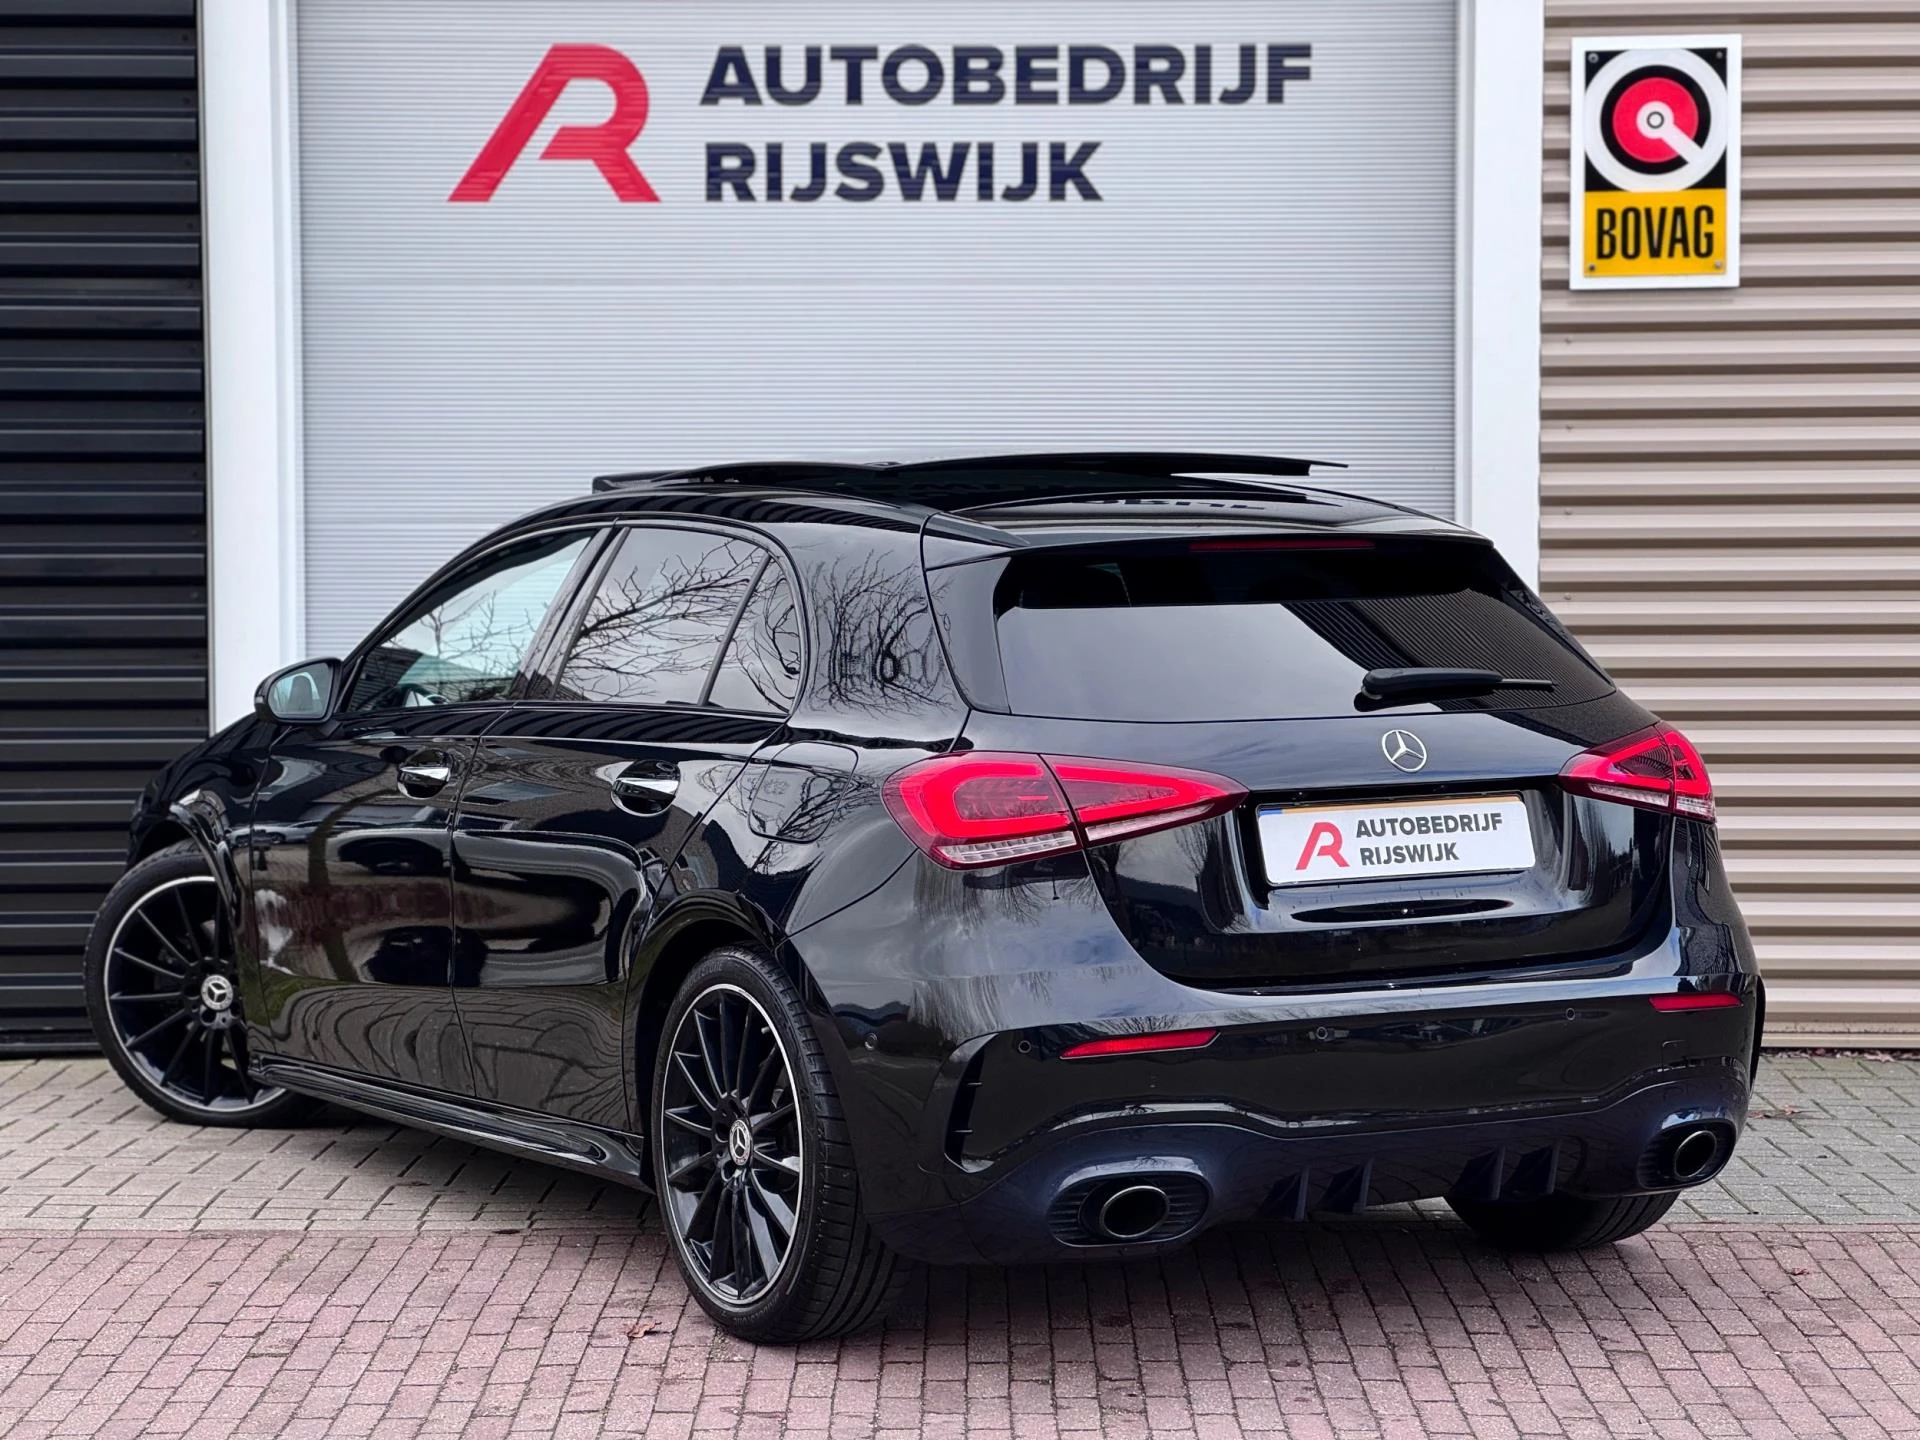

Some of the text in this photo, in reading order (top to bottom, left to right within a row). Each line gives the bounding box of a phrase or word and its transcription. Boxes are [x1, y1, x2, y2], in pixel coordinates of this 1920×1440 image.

[701, 43, 1312, 106] AUTOBEDRIJF
[705, 141, 1103, 203] RIJSWIJK
[1596, 204, 1714, 261] BOVAG
[1355, 812, 1503, 838] AUTOBEDRIJF
[1359, 842, 1459, 866] RIJSWIJK
